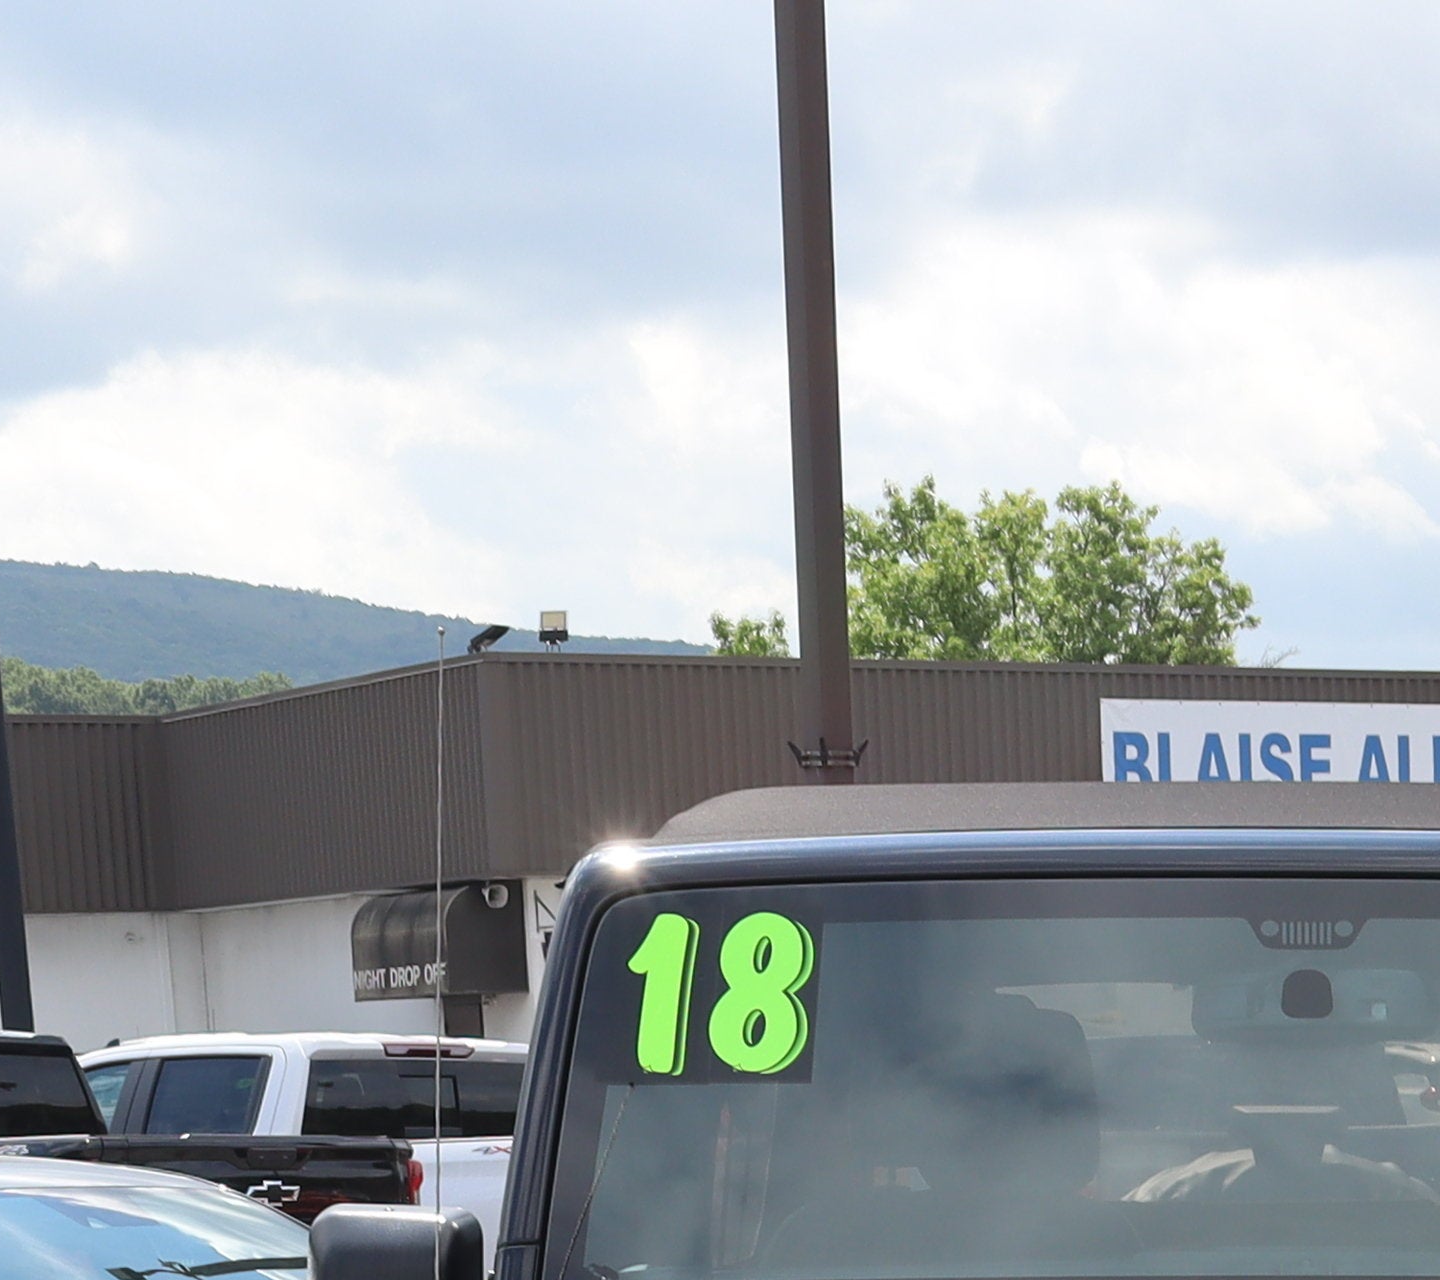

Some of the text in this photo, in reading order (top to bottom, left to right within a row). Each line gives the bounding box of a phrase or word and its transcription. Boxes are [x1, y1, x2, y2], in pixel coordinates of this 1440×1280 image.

[354, 961, 447, 990] NIGHT DROP OFF
[627, 911, 815, 1076] 18
